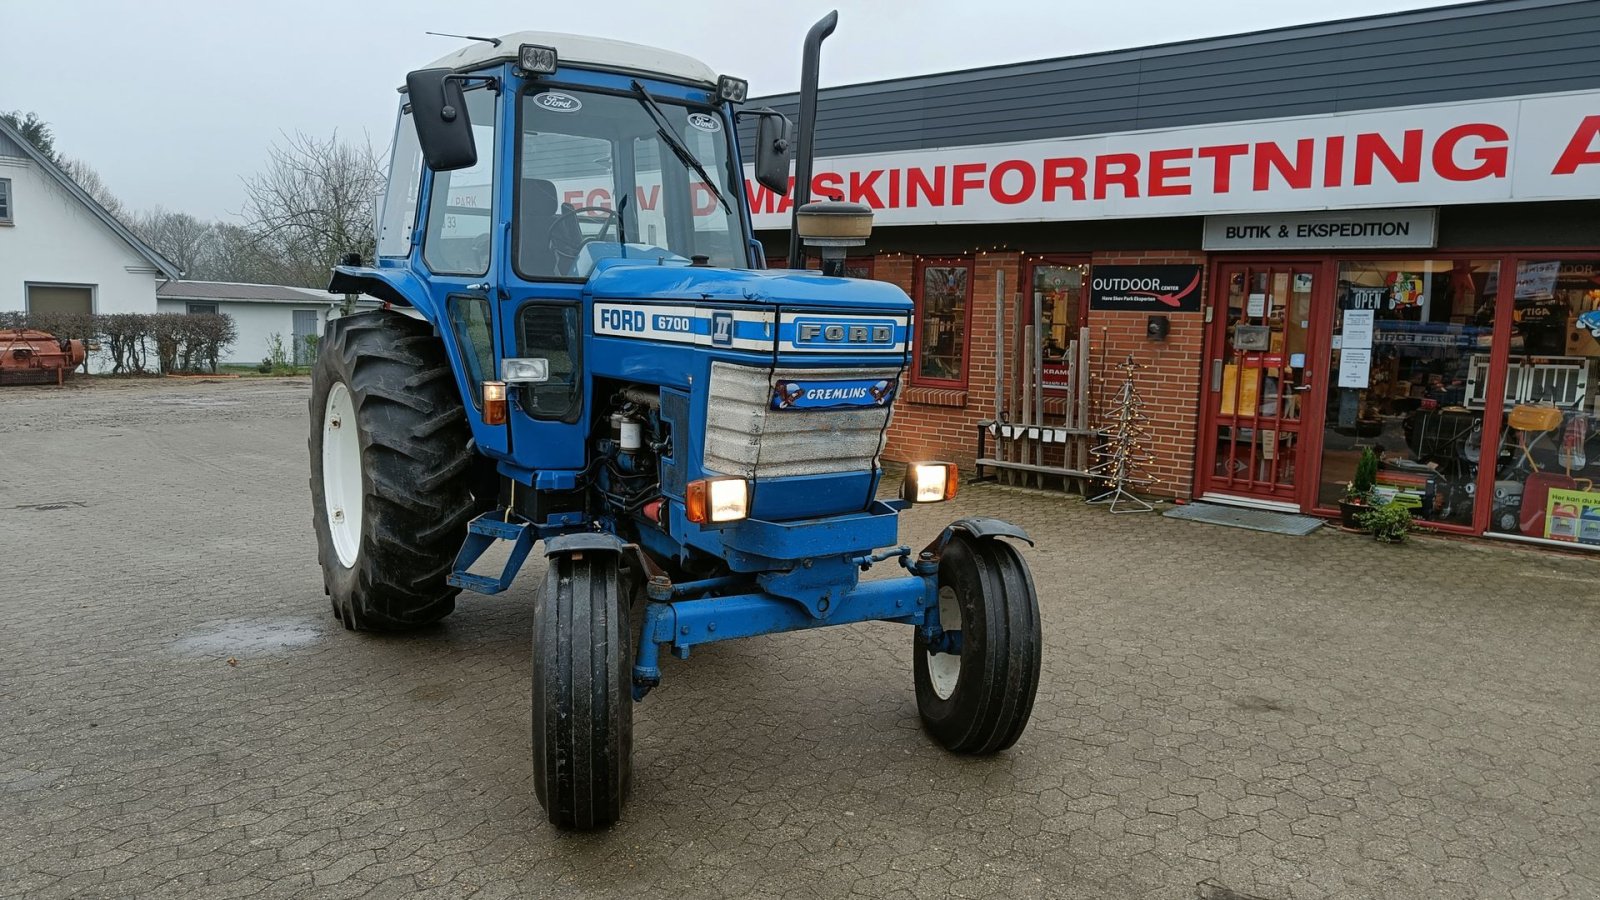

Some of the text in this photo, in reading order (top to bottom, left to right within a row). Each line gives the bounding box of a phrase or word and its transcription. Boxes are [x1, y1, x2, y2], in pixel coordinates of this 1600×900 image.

[544, 95, 572, 108] Ford
[694, 116, 714, 128] Ford
[455, 196, 478, 207] PARK
[564, 181, 717, 217] EGVD
[1225, 222, 1410, 239] BUTIK & EKSPEDITION
[1092, 278, 1161, 291] OUTDOOR
[1354, 293, 1381, 309] OPEN
[601, 308, 690, 332] FORD 6700
[800, 324, 892, 342] FORD
[806, 387, 867, 400] GREMLINS
